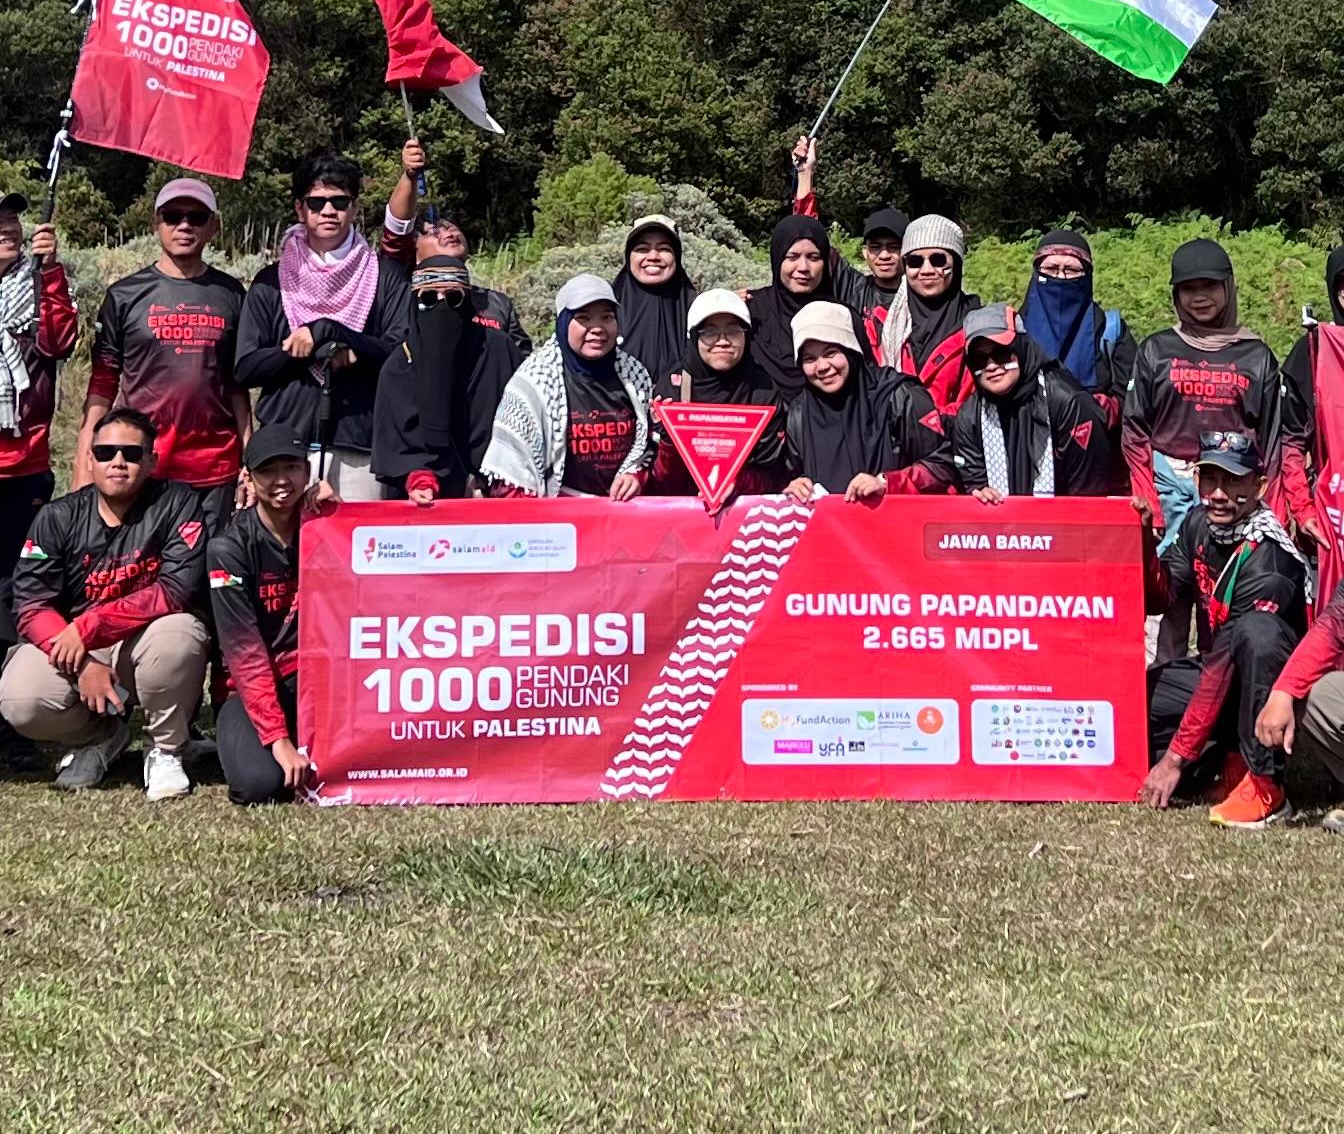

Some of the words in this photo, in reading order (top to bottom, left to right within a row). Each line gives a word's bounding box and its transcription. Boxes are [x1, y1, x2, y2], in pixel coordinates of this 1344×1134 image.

[116, 20, 188, 59] 1000
[189, 37, 244, 59] PENDAKI
[124, 47, 164, 67] UNTUK
[166, 61, 225, 82] PALESTINA
[188, 49, 237, 69] GUNUNG
[147, 313, 225, 329] EKSPEDISI
[152, 326, 193, 339] 1000
[1169, 369, 1250, 390] EKSPEDISI
[1174, 381, 1216, 396] 1000
[378, 542, 404, 551] Salam
[453, 544, 496, 554] salamaid
[938, 534, 991, 550] JAWA
[996, 535, 1053, 551] BARAT
[378, 550, 417, 559] Palestina
[785, 593, 911, 617] GUNUNG
[920, 594, 1114, 619] PAPANDAYAN
[349, 613, 646, 659] EKSPEDISI
[863, 626, 945, 650] 2.665
[956, 627, 1039, 651] MDPL
[516, 664, 629, 688] PENDAKI
[363, 666, 513, 713] 1000
[515, 686, 619, 709] GUNUNG
[390, 720, 466, 741] UNTUK
[473, 717, 601, 738] PALESTINA
